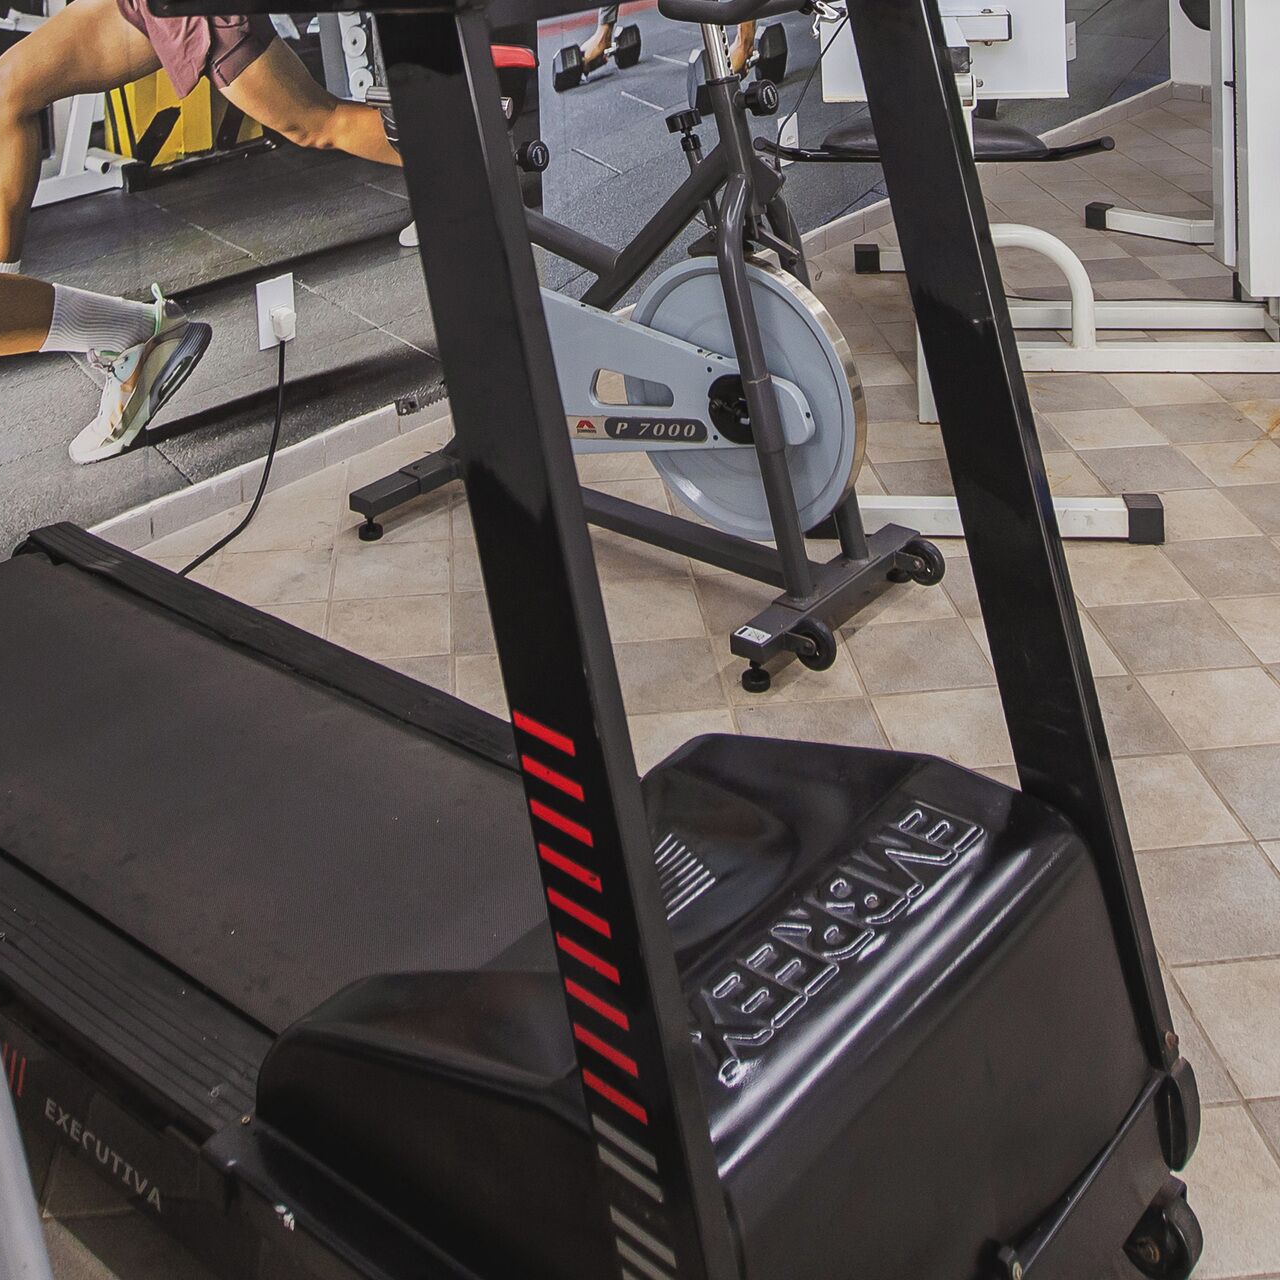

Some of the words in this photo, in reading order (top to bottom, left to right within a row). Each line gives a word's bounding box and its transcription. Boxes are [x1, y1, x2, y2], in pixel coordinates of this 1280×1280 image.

[615, 422, 628, 435] P
[638, 422, 696, 438] 7000
[689, 800, 985, 1087] EMBREEX
[45, 1098, 161, 1212] EXECUTIVA
